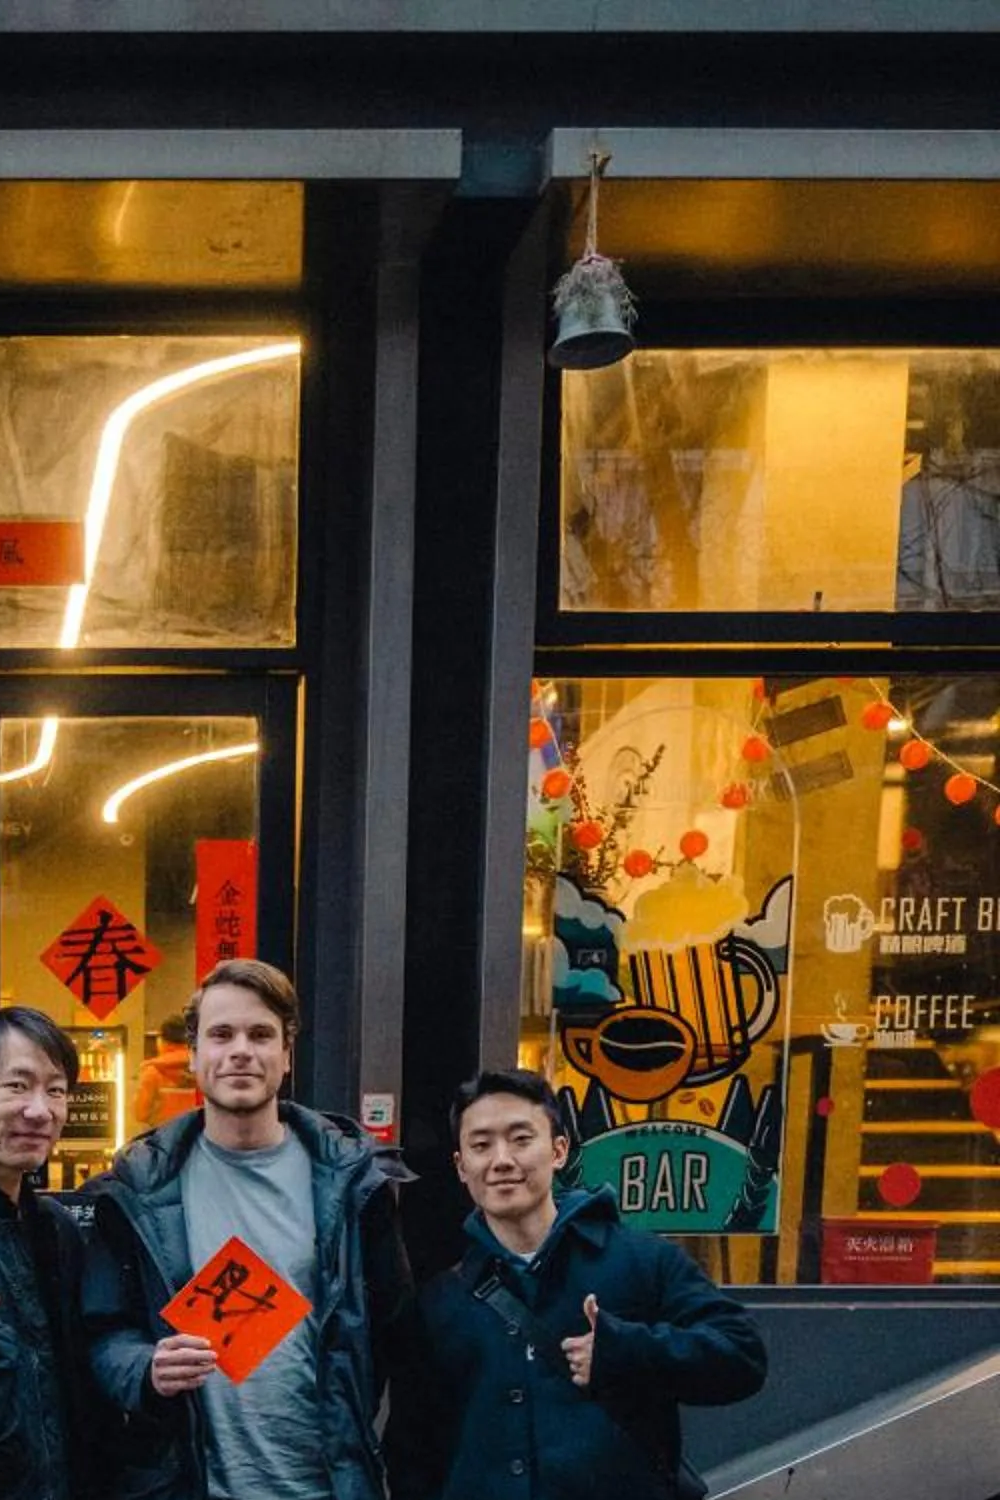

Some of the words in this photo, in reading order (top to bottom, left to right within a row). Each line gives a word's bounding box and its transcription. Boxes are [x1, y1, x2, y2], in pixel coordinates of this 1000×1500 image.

[880, 897, 967, 932] CRAFT
[977, 897, 1000, 932] B
[55, 909, 152, 1004] 春
[875, 995, 976, 1029] COFFEE
[620, 1151, 709, 1212] BAR
